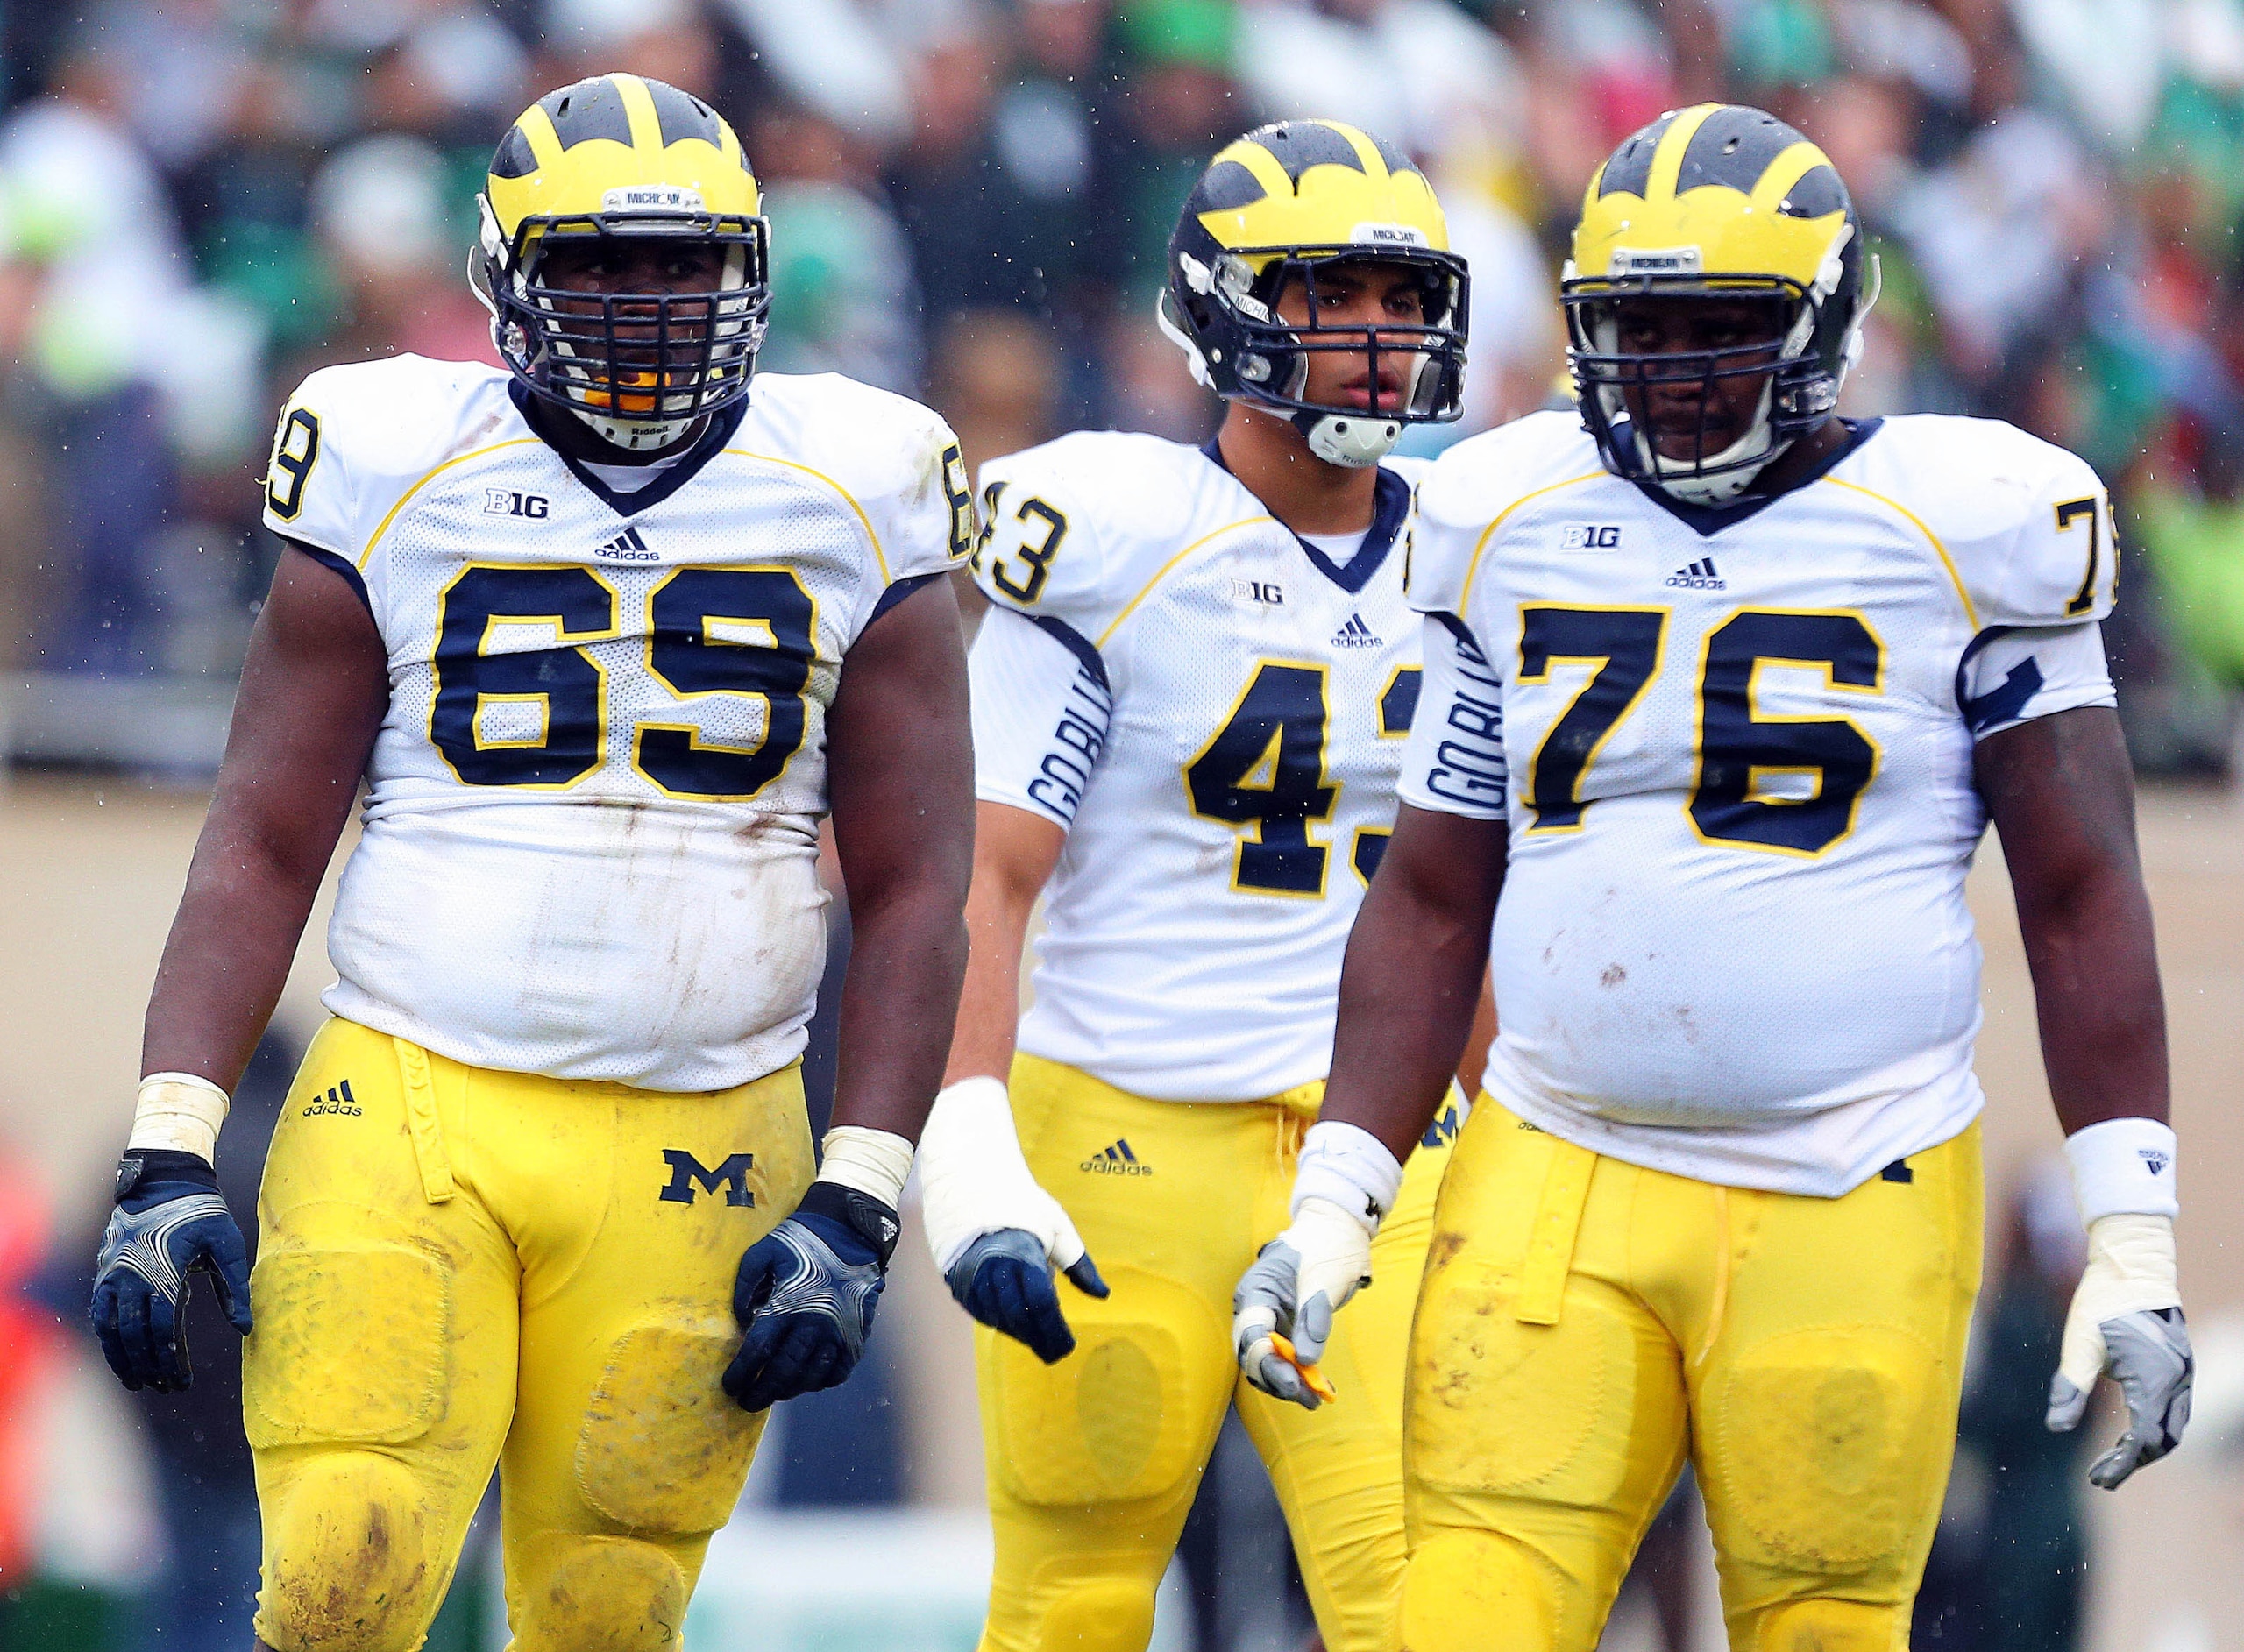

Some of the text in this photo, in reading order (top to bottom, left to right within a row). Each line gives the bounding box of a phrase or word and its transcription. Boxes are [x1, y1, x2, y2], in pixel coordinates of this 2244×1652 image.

[261, 394, 322, 524] 9
[594, 548, 660, 561] adidas
[2051, 487, 2122, 617] 7
[1665, 575, 1727, 591] adidas
[1331, 635, 1384, 649] adidas
[427, 561, 822, 803] 69
[1515, 600, 1889, 860] 76
[302, 1101, 362, 1117] adidas
[658, 1149, 756, 1208] M
[1080, 1159, 1153, 1176] adidas
